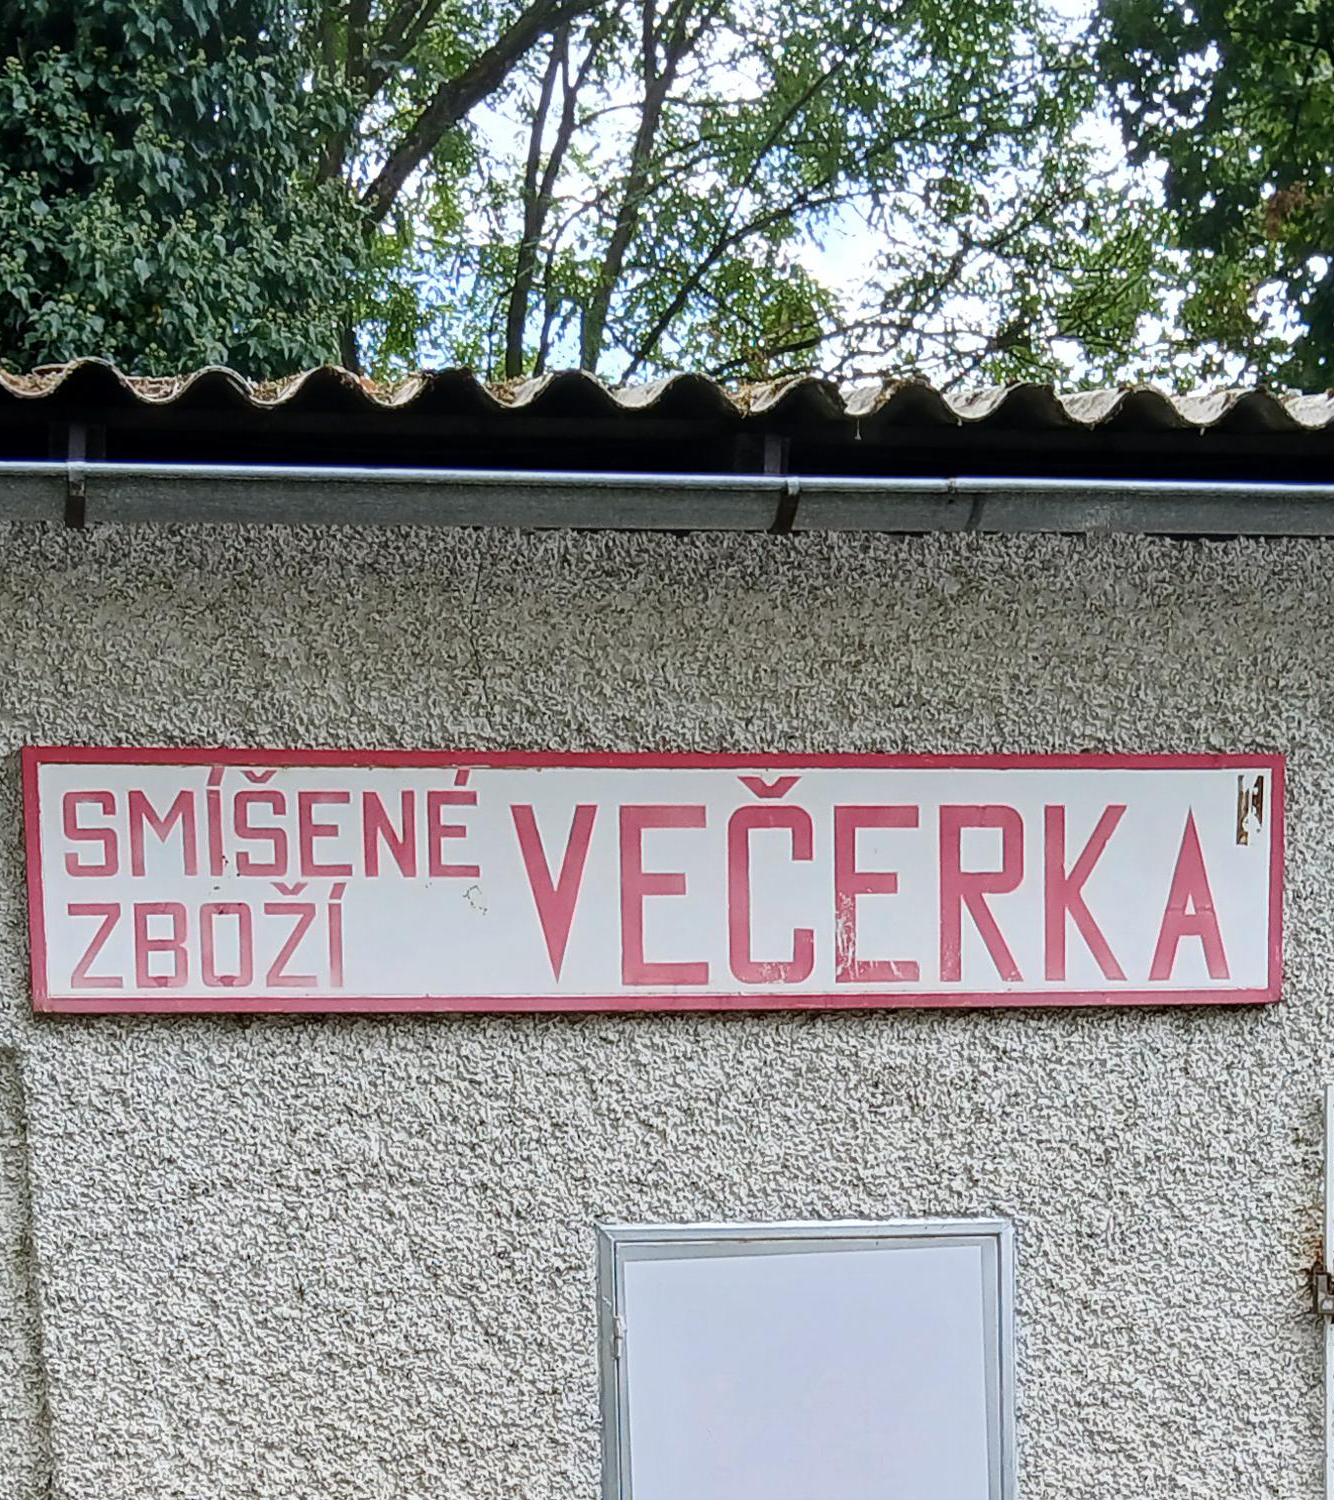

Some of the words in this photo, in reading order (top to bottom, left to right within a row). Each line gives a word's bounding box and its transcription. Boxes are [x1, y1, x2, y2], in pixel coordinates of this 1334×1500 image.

[62, 767, 481, 878] SMÍŠENÉ
[67, 883, 347, 989] ZBOŽÍ
[510, 776, 1233, 986] VEČERKA
